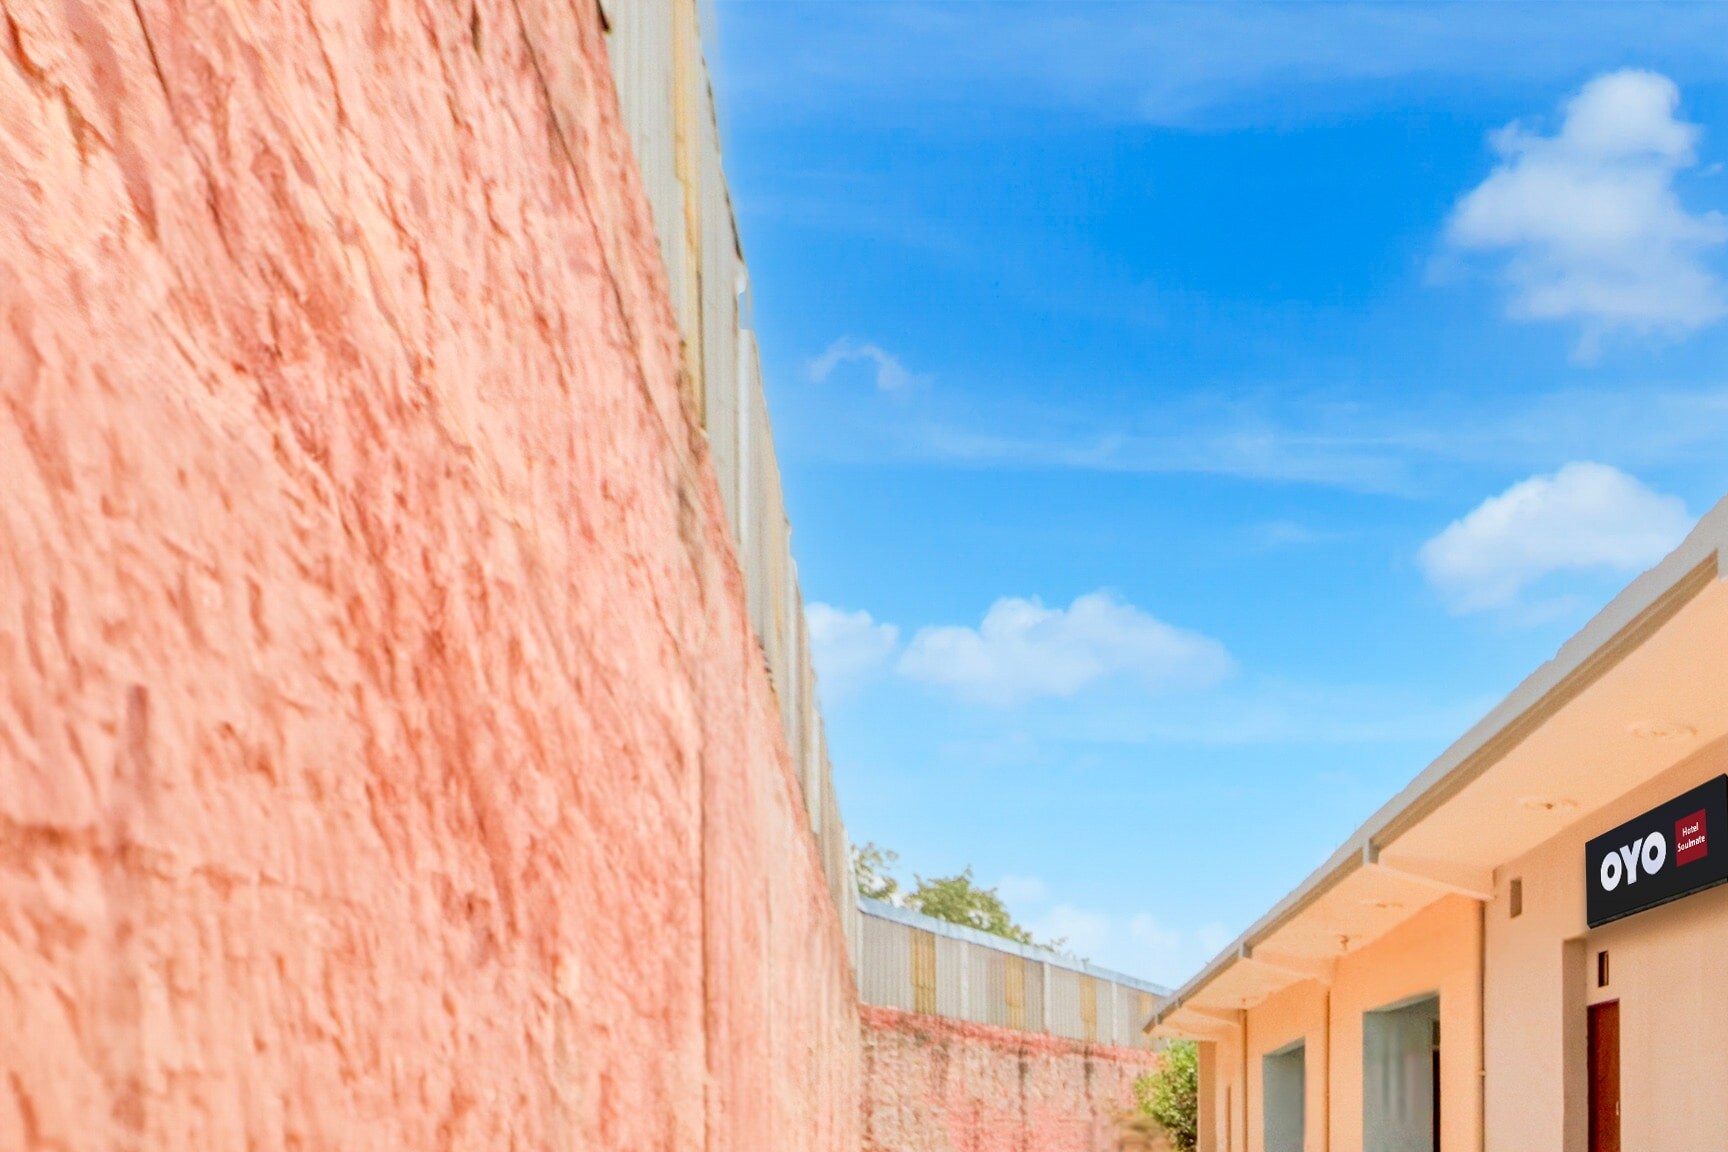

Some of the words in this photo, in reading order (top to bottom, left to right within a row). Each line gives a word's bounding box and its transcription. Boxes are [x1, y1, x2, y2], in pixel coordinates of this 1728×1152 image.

[1682, 822, 1699, 836] Hotel
[1677, 835, 1706, 852] Soulmate
[1601, 831, 1667, 892] OYO
